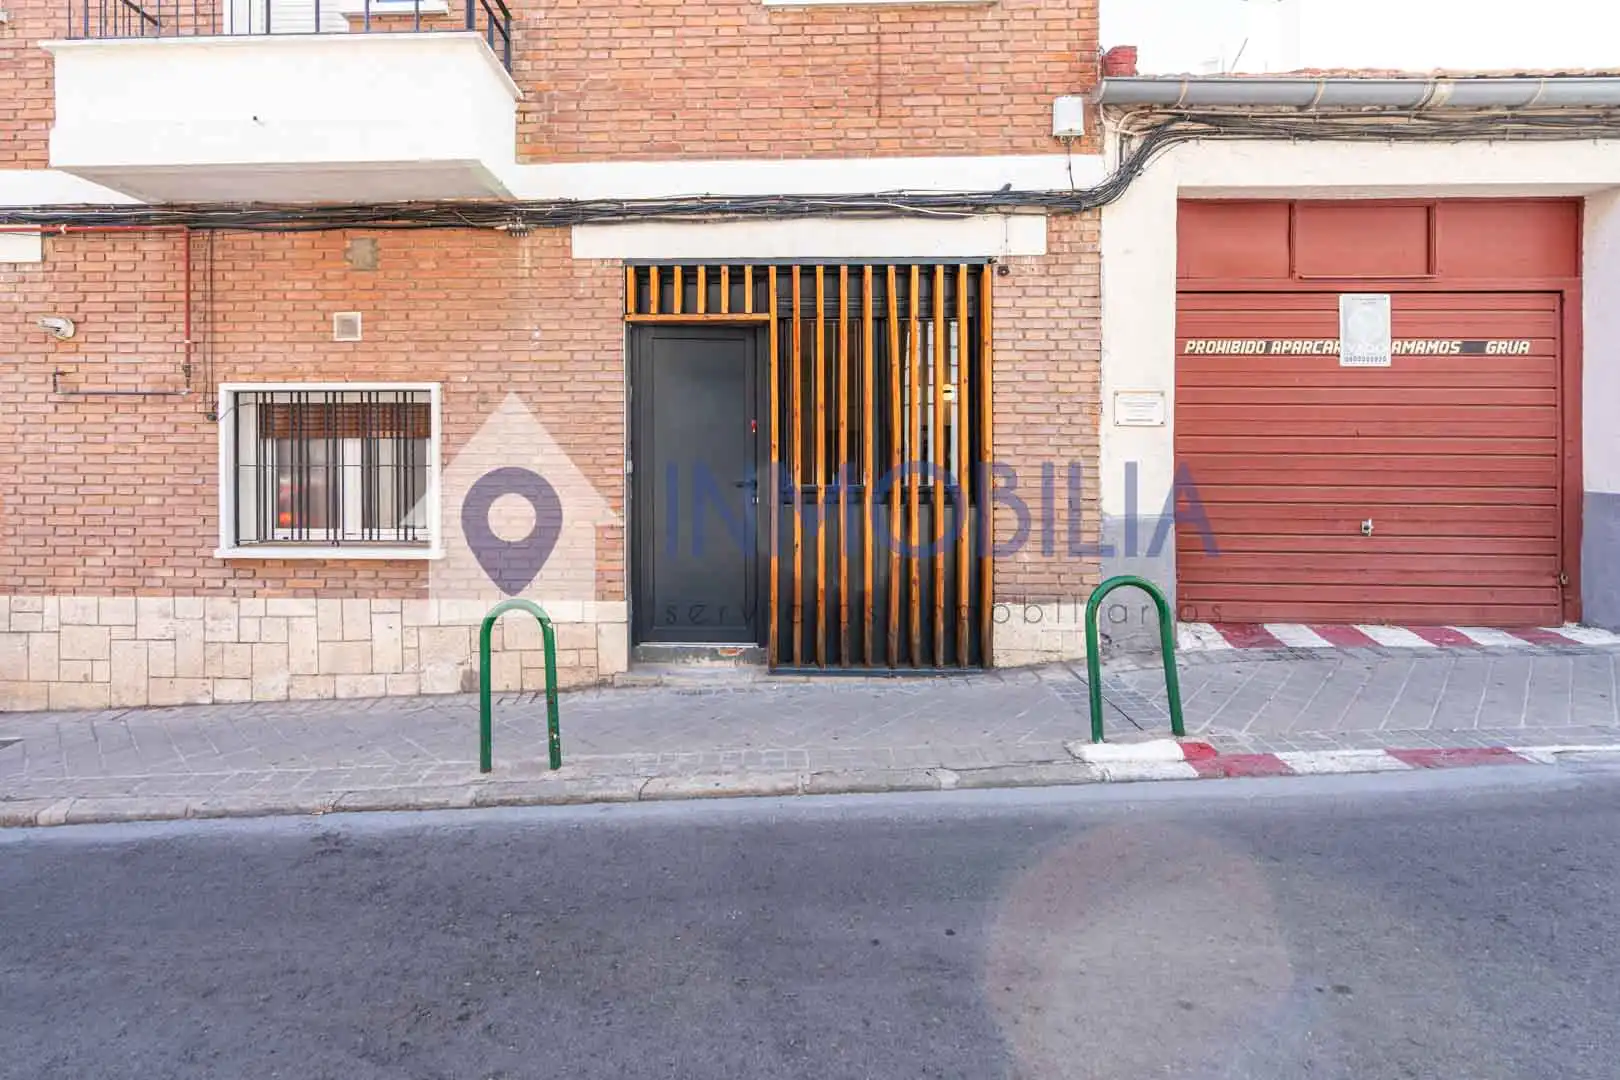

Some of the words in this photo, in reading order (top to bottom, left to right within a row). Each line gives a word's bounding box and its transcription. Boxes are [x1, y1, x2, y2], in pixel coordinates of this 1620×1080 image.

[1184, 340, 1266, 355] PROHIBIDO
[1391, 340, 1462, 355] AMAMOS
[1485, 340, 1531, 355] GRUA
